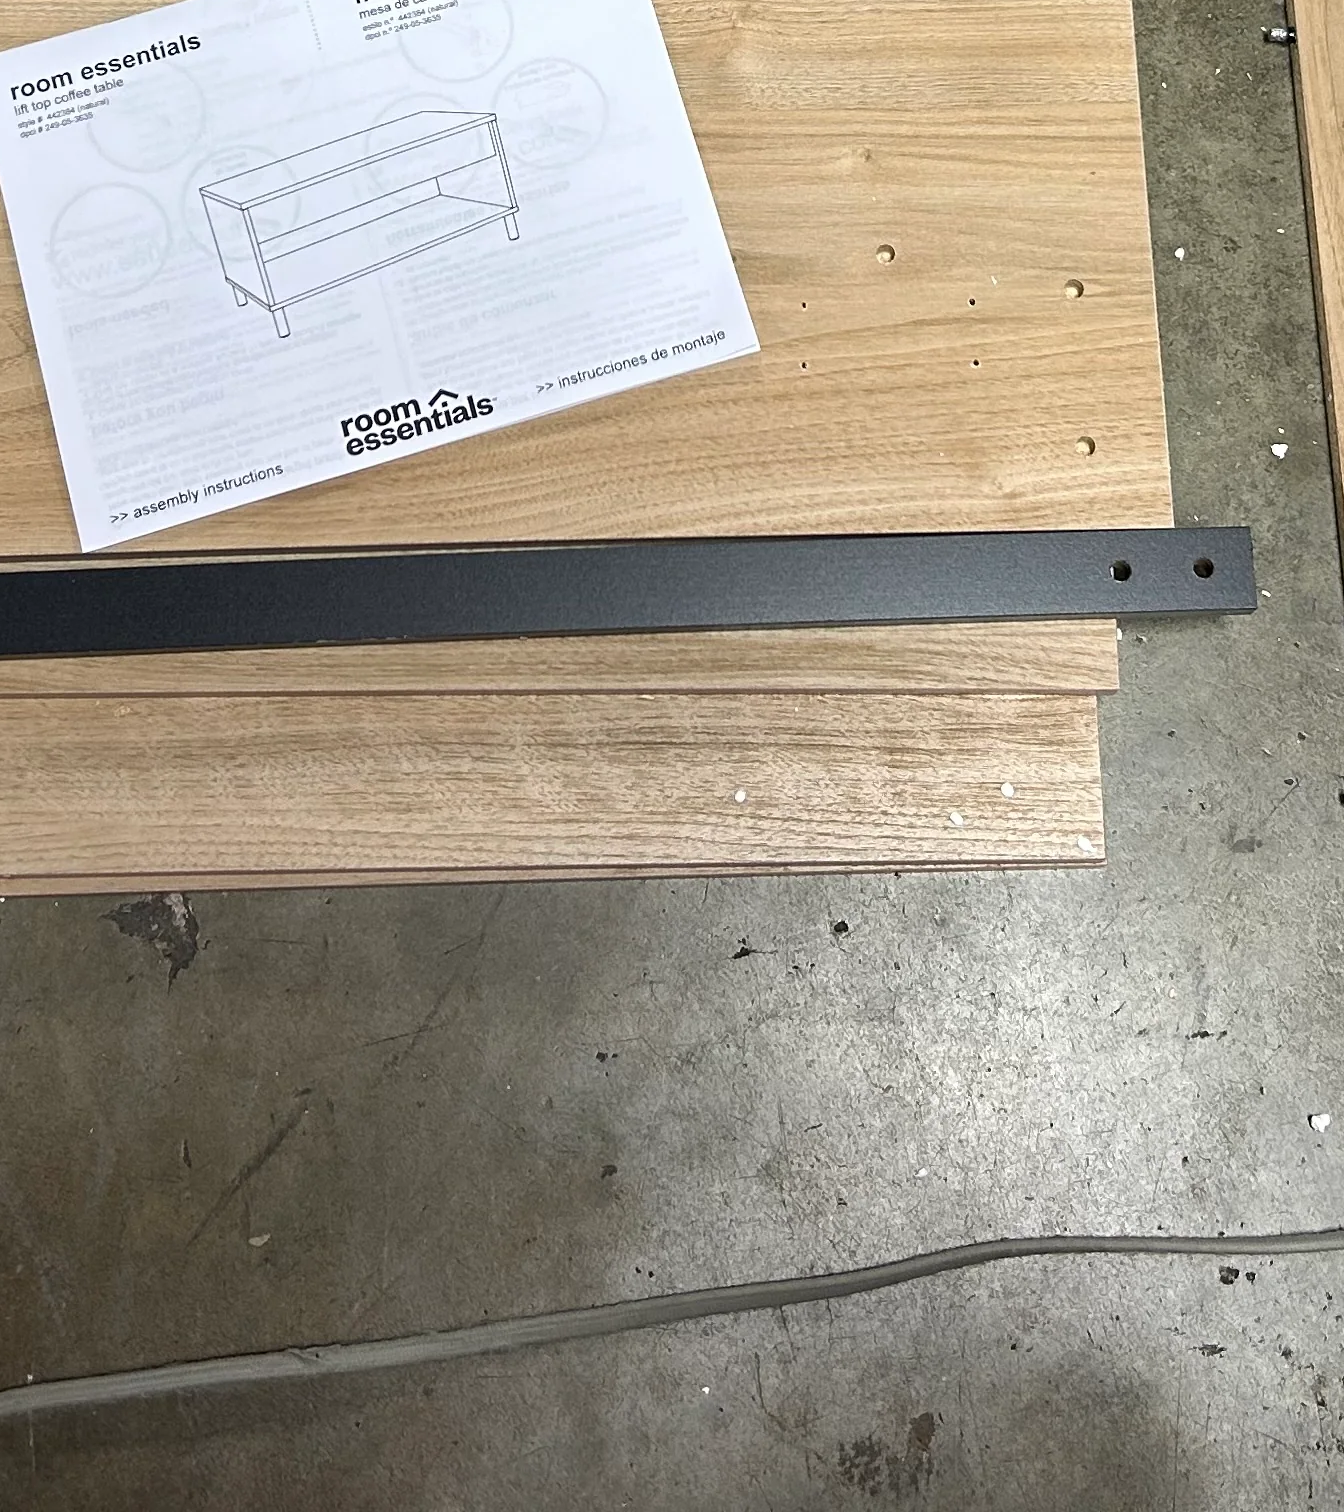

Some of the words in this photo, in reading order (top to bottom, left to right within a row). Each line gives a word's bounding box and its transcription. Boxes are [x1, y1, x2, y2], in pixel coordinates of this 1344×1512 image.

[359, 2, 392, 19] mesa
[10, 71, 73, 100] room
[81, 34, 201, 80] essentials
[14, 104, 29, 116] lift
[32, 97, 51, 111] top
[54, 88, 92, 105] coffee
[94, 78, 125, 94] table
[558, 354, 648, 389] instrucciones
[651, 348, 669, 362] de
[671, 329, 726, 357] montaje
[341, 398, 422, 438] room
[346, 395, 494, 456] essentials
[133, 487, 200, 519] assembly
[203, 462, 284, 498] instructions
